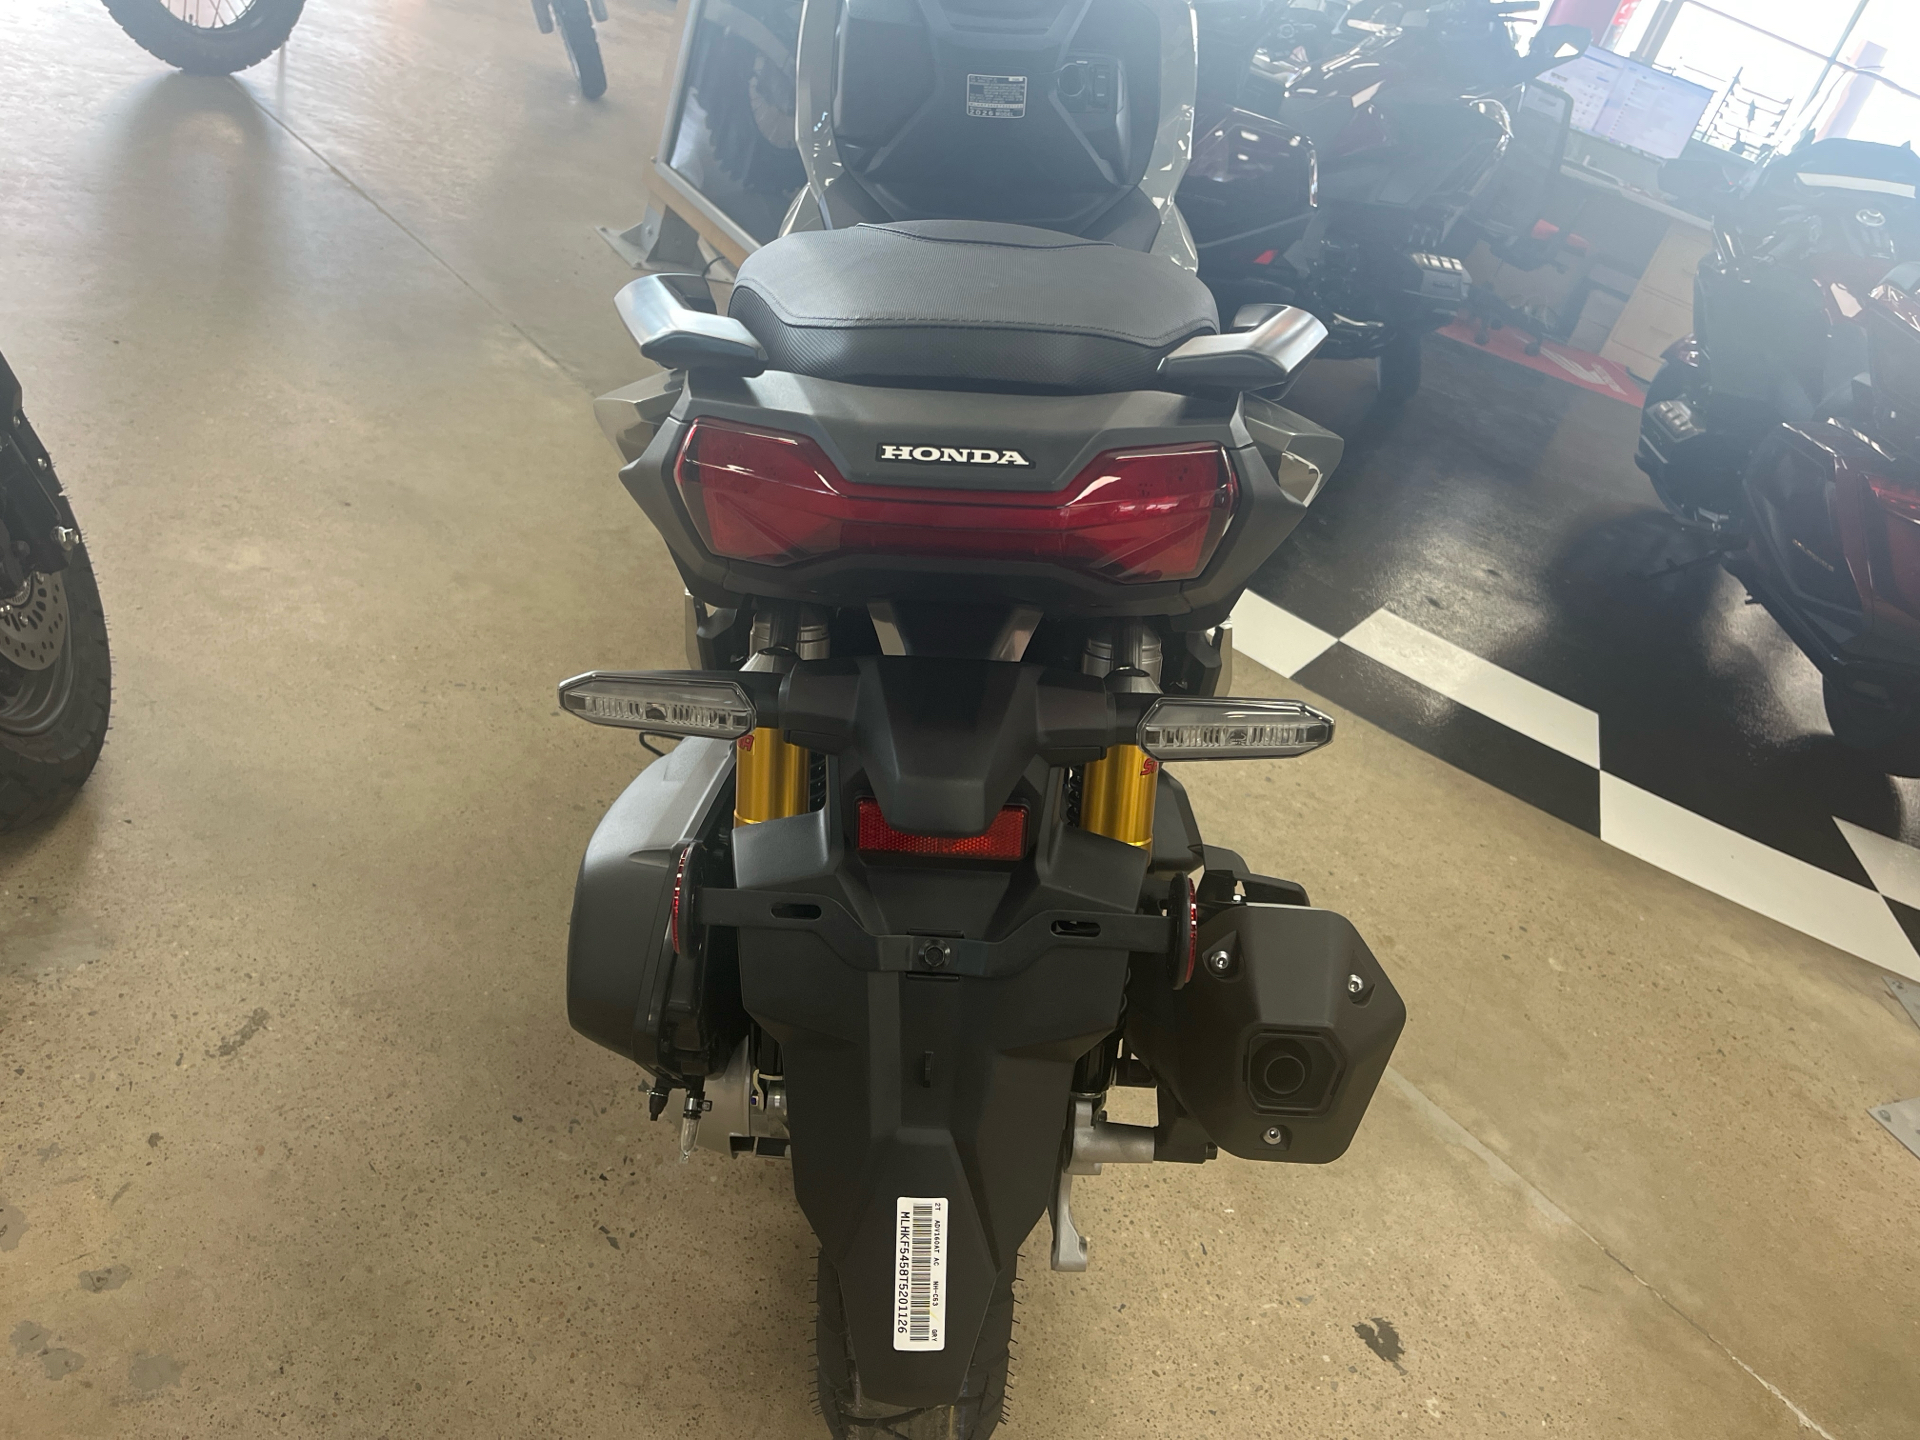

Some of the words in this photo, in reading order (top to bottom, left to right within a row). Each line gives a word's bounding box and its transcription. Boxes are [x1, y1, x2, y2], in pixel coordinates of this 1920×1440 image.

[881, 445, 1029, 465] HONDA
[933, 1257, 939, 1266] AC
[898, 1211, 910, 1334] MLHKF5458T5201126
